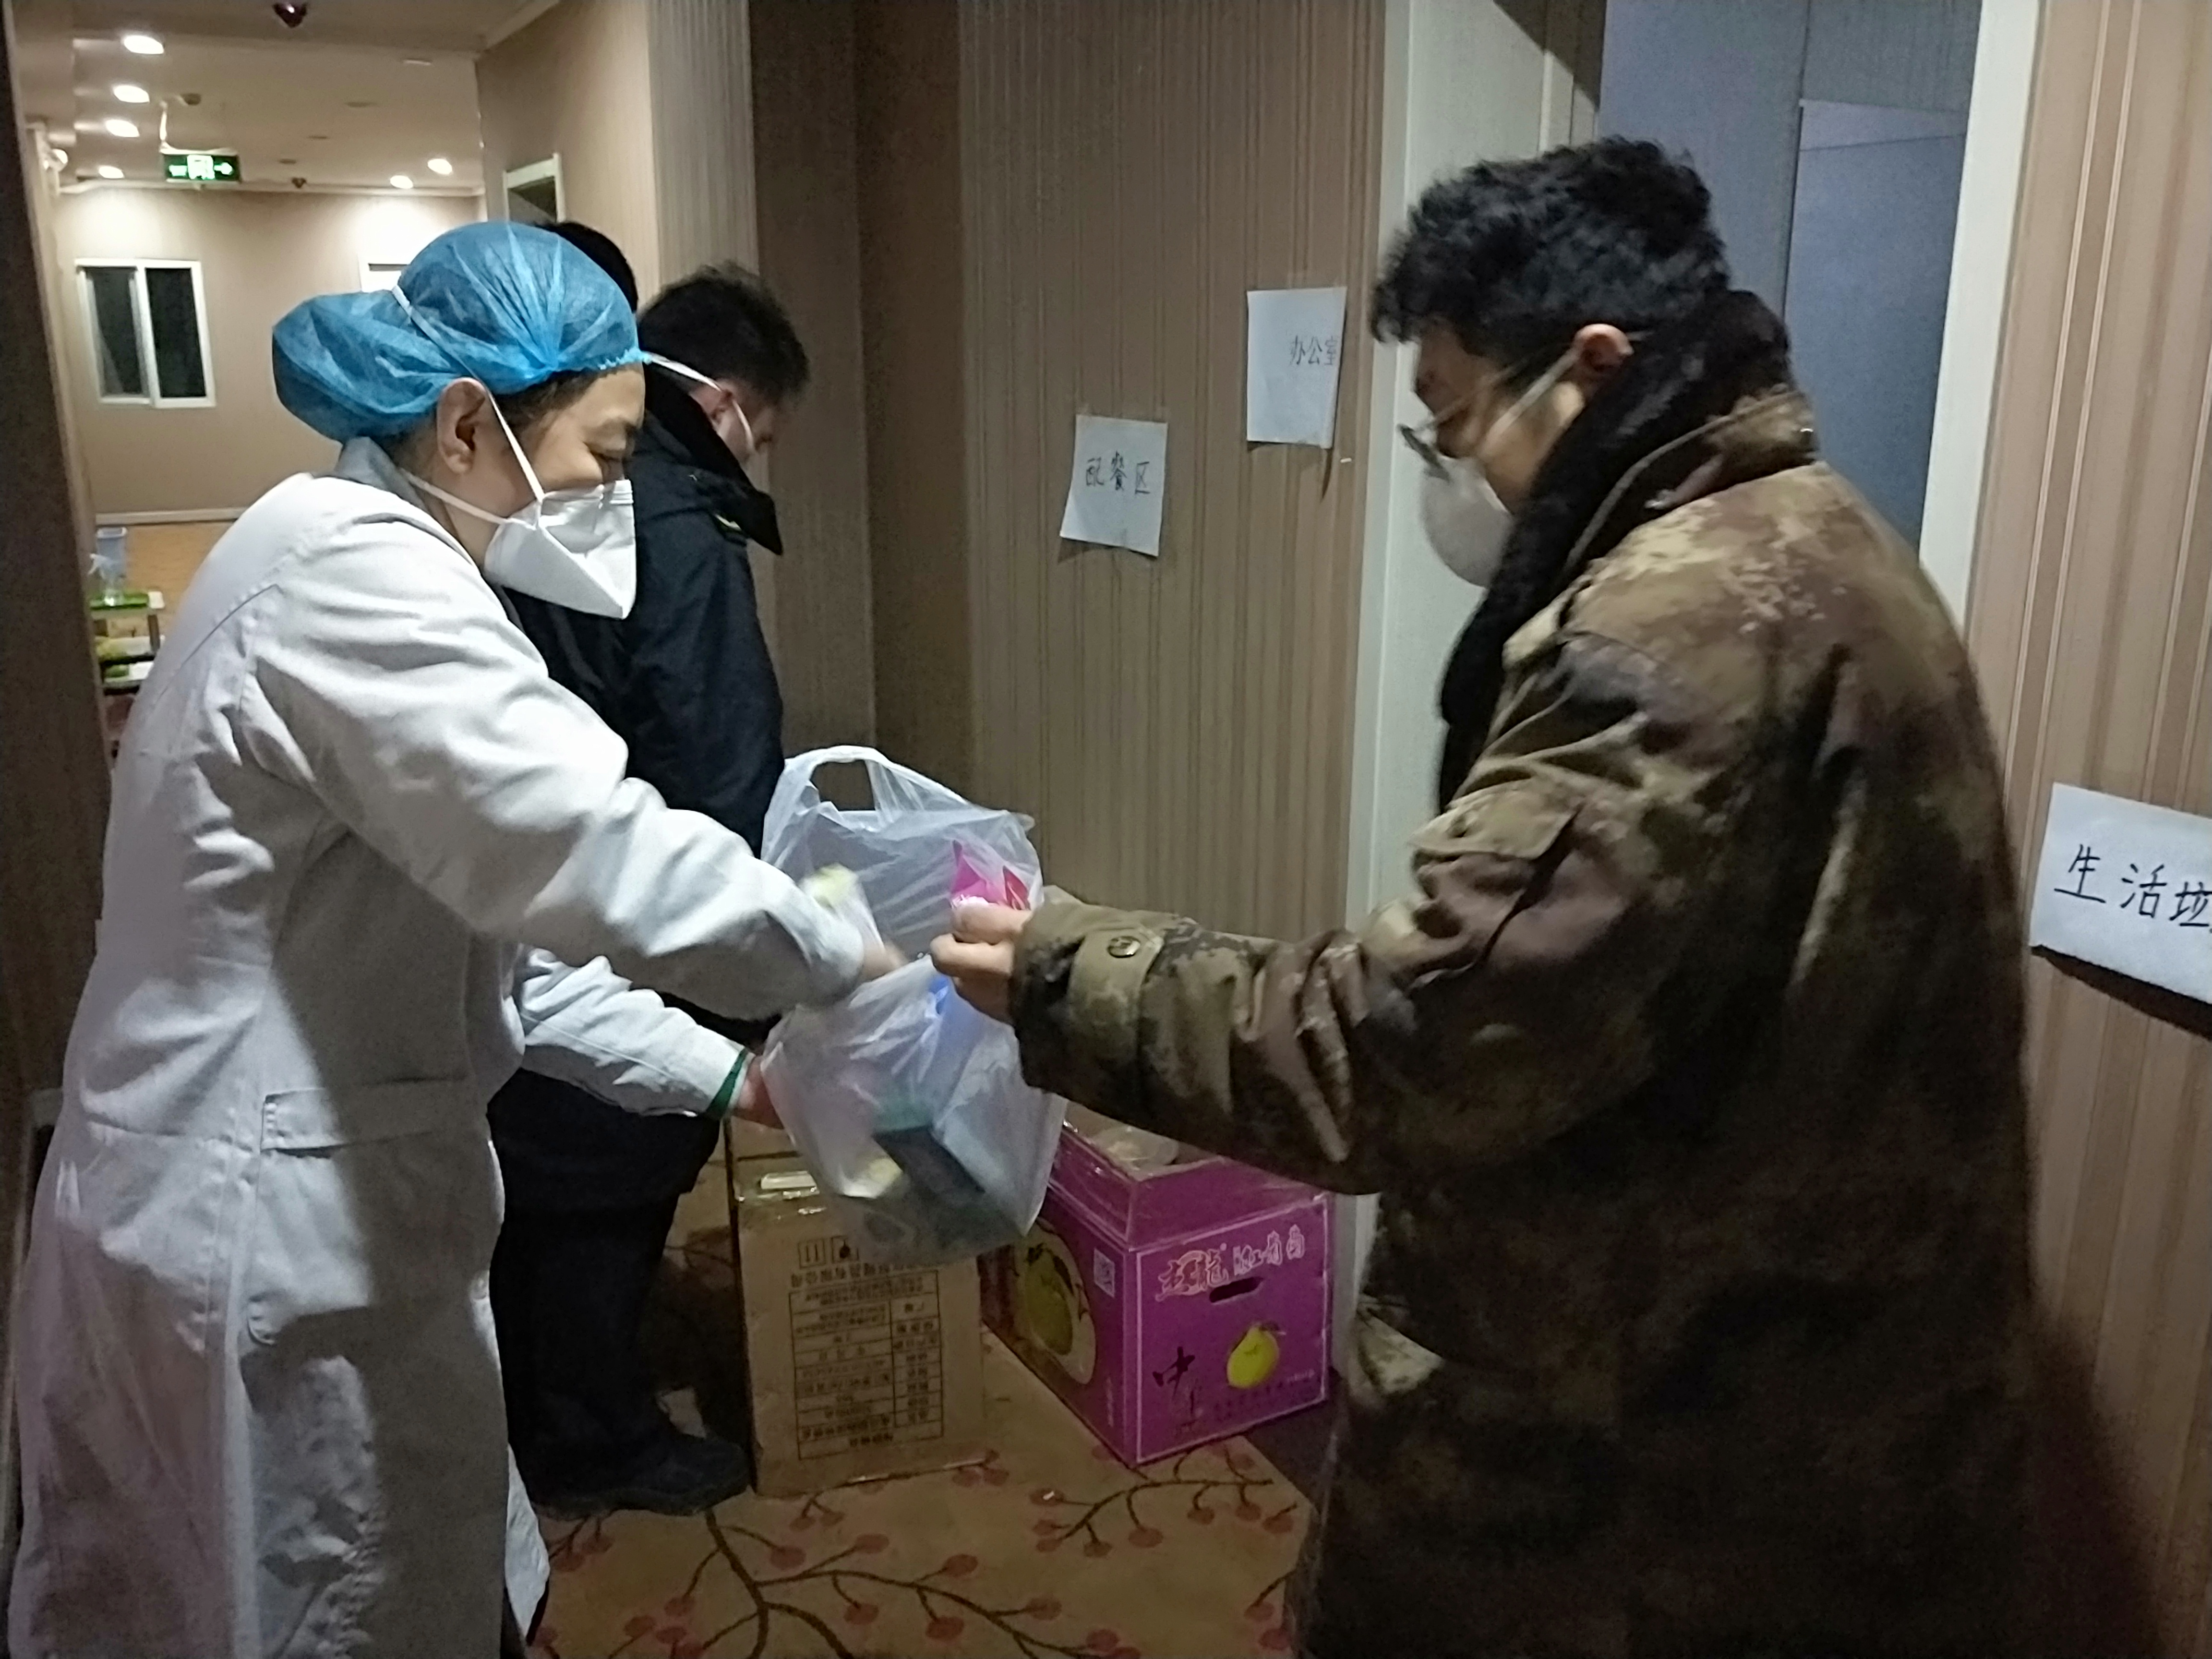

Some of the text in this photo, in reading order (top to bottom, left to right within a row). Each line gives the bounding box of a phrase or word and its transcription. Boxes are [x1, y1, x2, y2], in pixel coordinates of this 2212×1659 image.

[1289, 335, 1337, 365] 办公室
[1085, 450, 1151, 495] 配餐区
[2054, 844, 2212, 933] 生活垃
